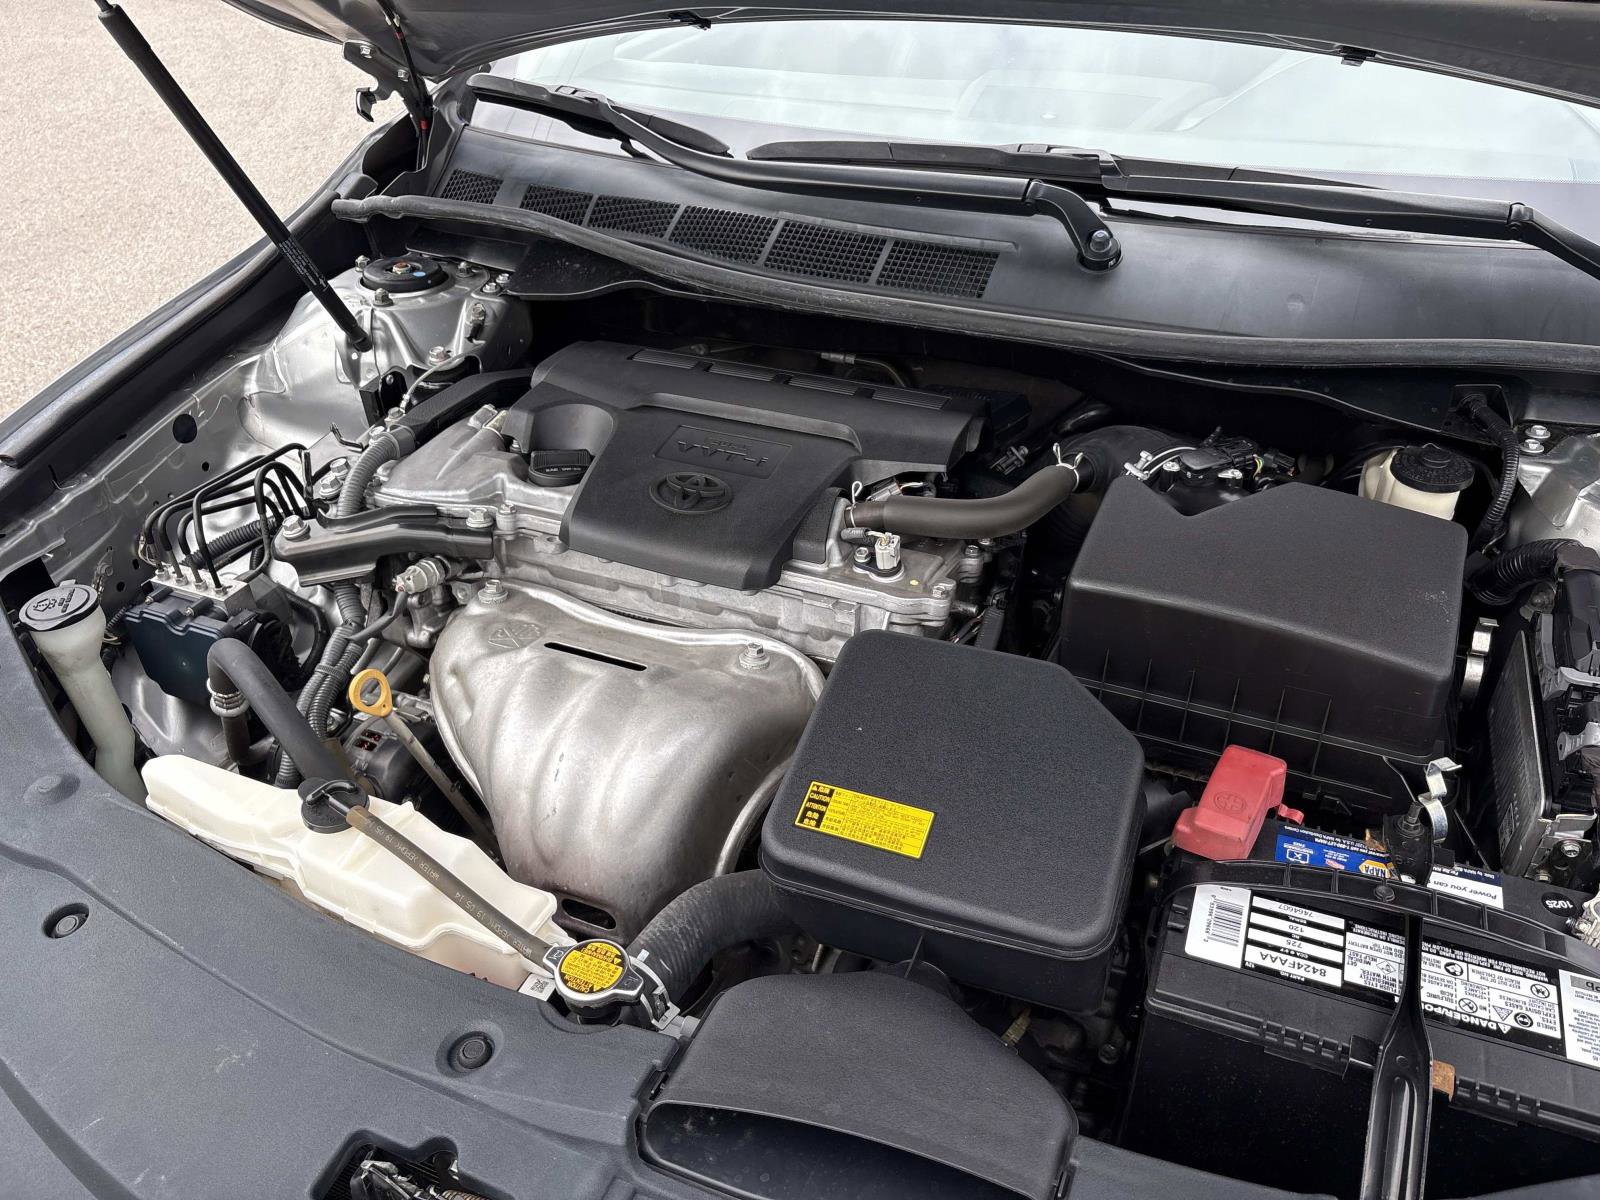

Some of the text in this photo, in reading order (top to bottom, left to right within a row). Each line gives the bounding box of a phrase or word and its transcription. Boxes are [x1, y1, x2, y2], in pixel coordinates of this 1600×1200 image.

[809, 791, 830, 802] CAUTION
[1364, 865, 1385, 878] NAPA
[1433, 880, 1448, 888] can
[1450, 883, 1467, 892] you
[1469, 889, 1497, 900] Power
[1545, 899, 1574, 909] 10/25
[1287, 924, 1305, 933] 120
[1285, 939, 1303, 948] 725
[1368, 945, 1382, 953] OPEN
[1345, 954, 1371, 965] MEDICAL
[1348, 950, 1377, 962] HELP FAST
[1258, 951, 1326, 977] 8424FAAA
[566, 980, 589, 993] CAUTION
[1378, 983, 1397, 992] FLUSH
[1425, 991, 1454, 1003] SULFURIC
[1503, 1000, 1556, 1019] EXPLOSIVE GASES
[1421, 1002, 1497, 1030] DANGER/POI
